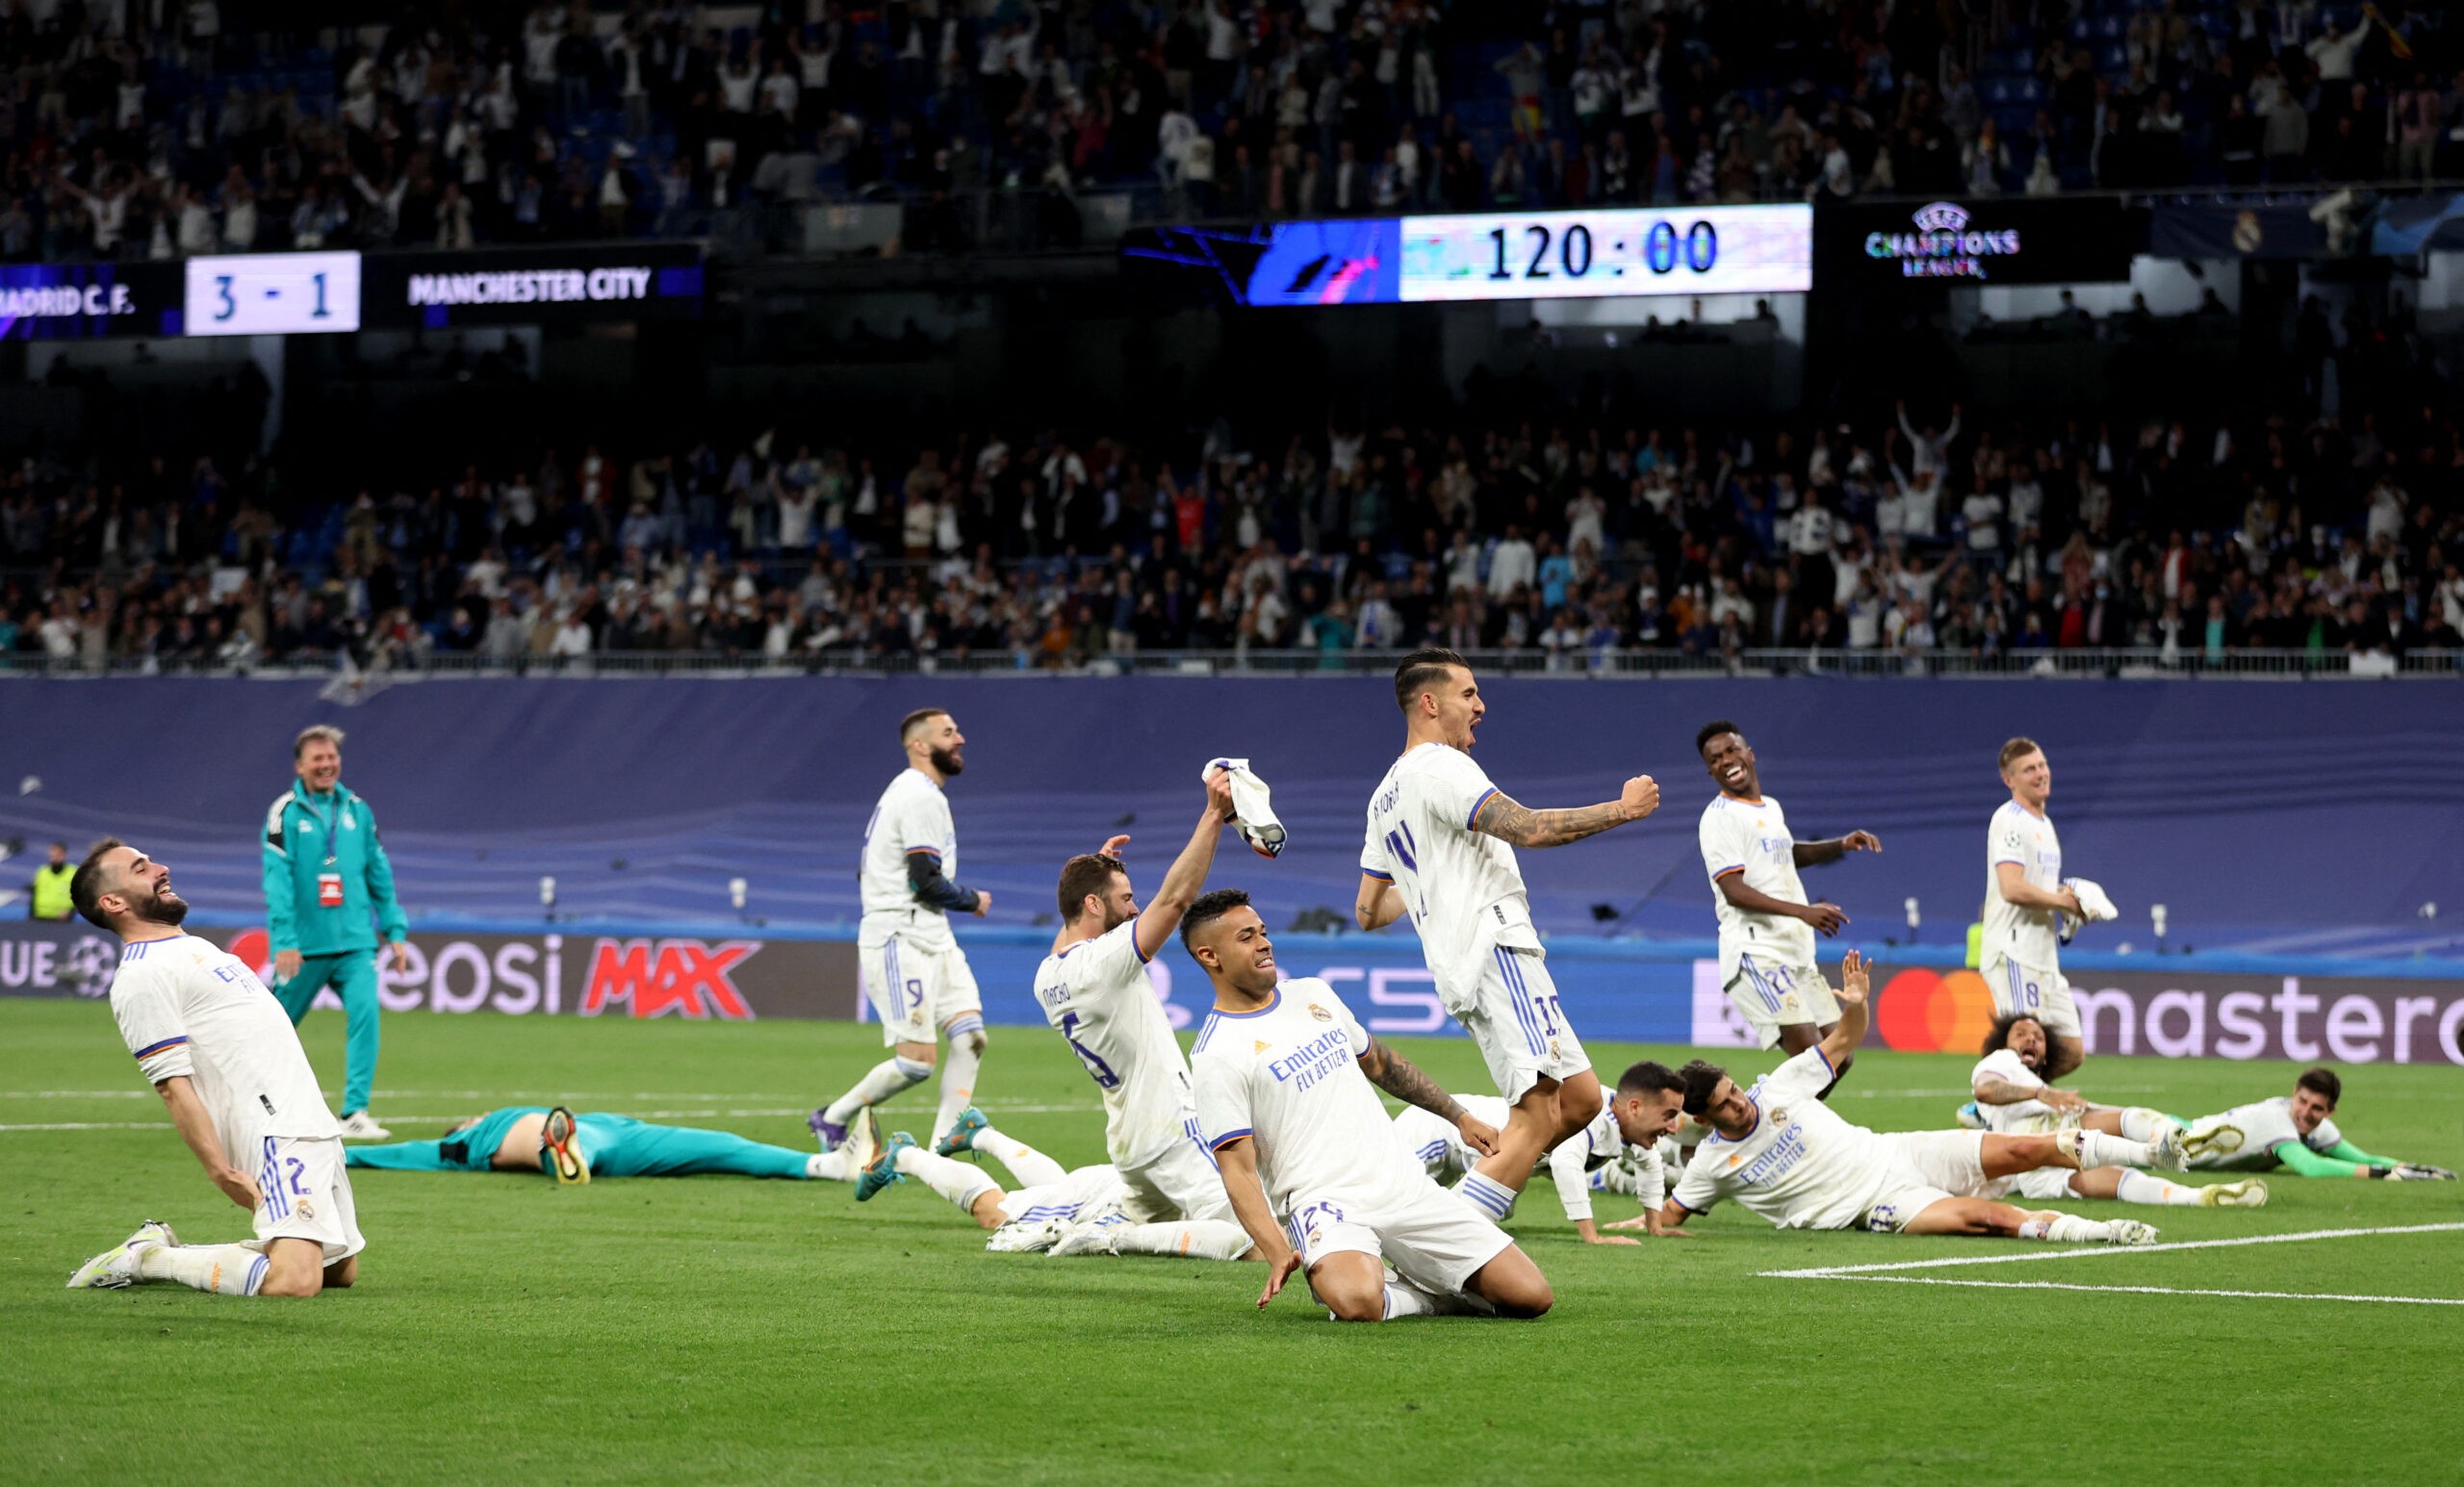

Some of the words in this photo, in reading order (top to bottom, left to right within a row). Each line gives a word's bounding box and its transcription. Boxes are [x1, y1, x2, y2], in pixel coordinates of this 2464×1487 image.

[214, 273, 237, 321] 3
[311, 272, 332, 319] 1
[407, 269, 586, 306] MANCHESTER
[587, 267, 652, 300] CITY
[312, 934, 562, 1014] epsi
[580, 936, 763, 1021] MAX
[906, 978, 924, 1009] 9
[1042, 982, 1070, 1008] NACHO
[2026, 982, 2040, 1008] 8
[1268, 1028, 1348, 1082] Emirates
[1296, 1068, 1316, 1092] FLY
[1314, 1048, 1349, 1080] BETTER
[1739, 1122, 1803, 1185] Emirates
[286, 1157, 312, 1196] 2
